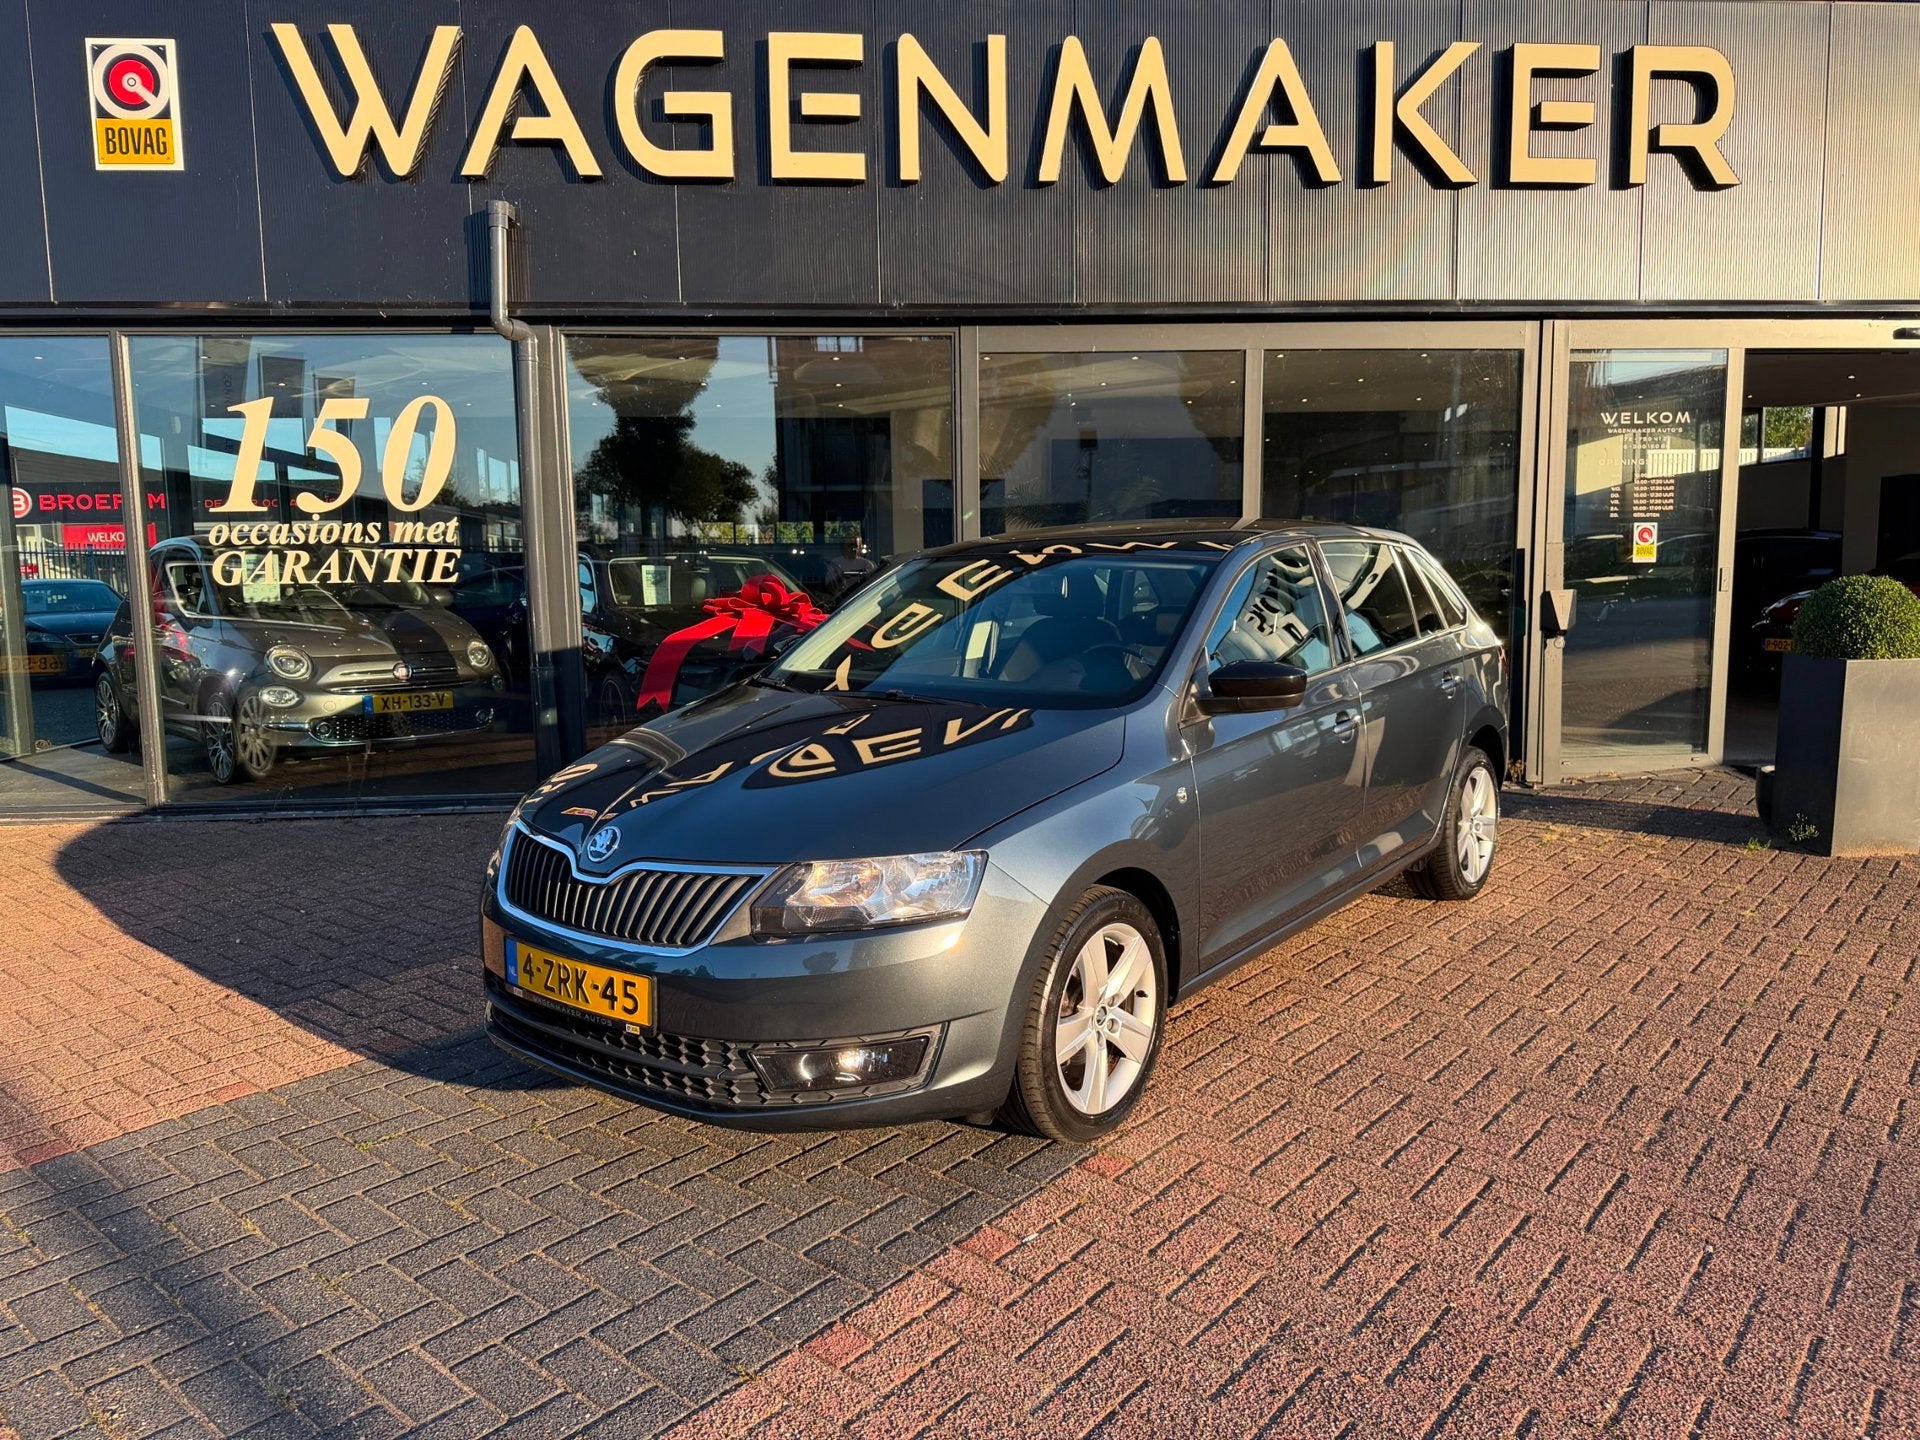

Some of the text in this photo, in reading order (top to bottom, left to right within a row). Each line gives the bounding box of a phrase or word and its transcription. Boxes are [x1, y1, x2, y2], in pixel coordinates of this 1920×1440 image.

[270, 22, 1740, 186] WAGENMAKER
[104, 127, 168, 155] BOVAG
[1600, 411, 1691, 424] WELKOM
[208, 395, 457, 513] 150
[39, 493, 166, 511] BROEM
[87, 532, 125, 543] WELKO
[208, 513, 459, 546] occasions met
[211, 548, 462, 586] GARANTIE
[381, 692, 446, 711] XH-133-V
[522, 953, 639, 1015] 4-ZRK-45
[584, 1013, 613, 1027] AUTOS
